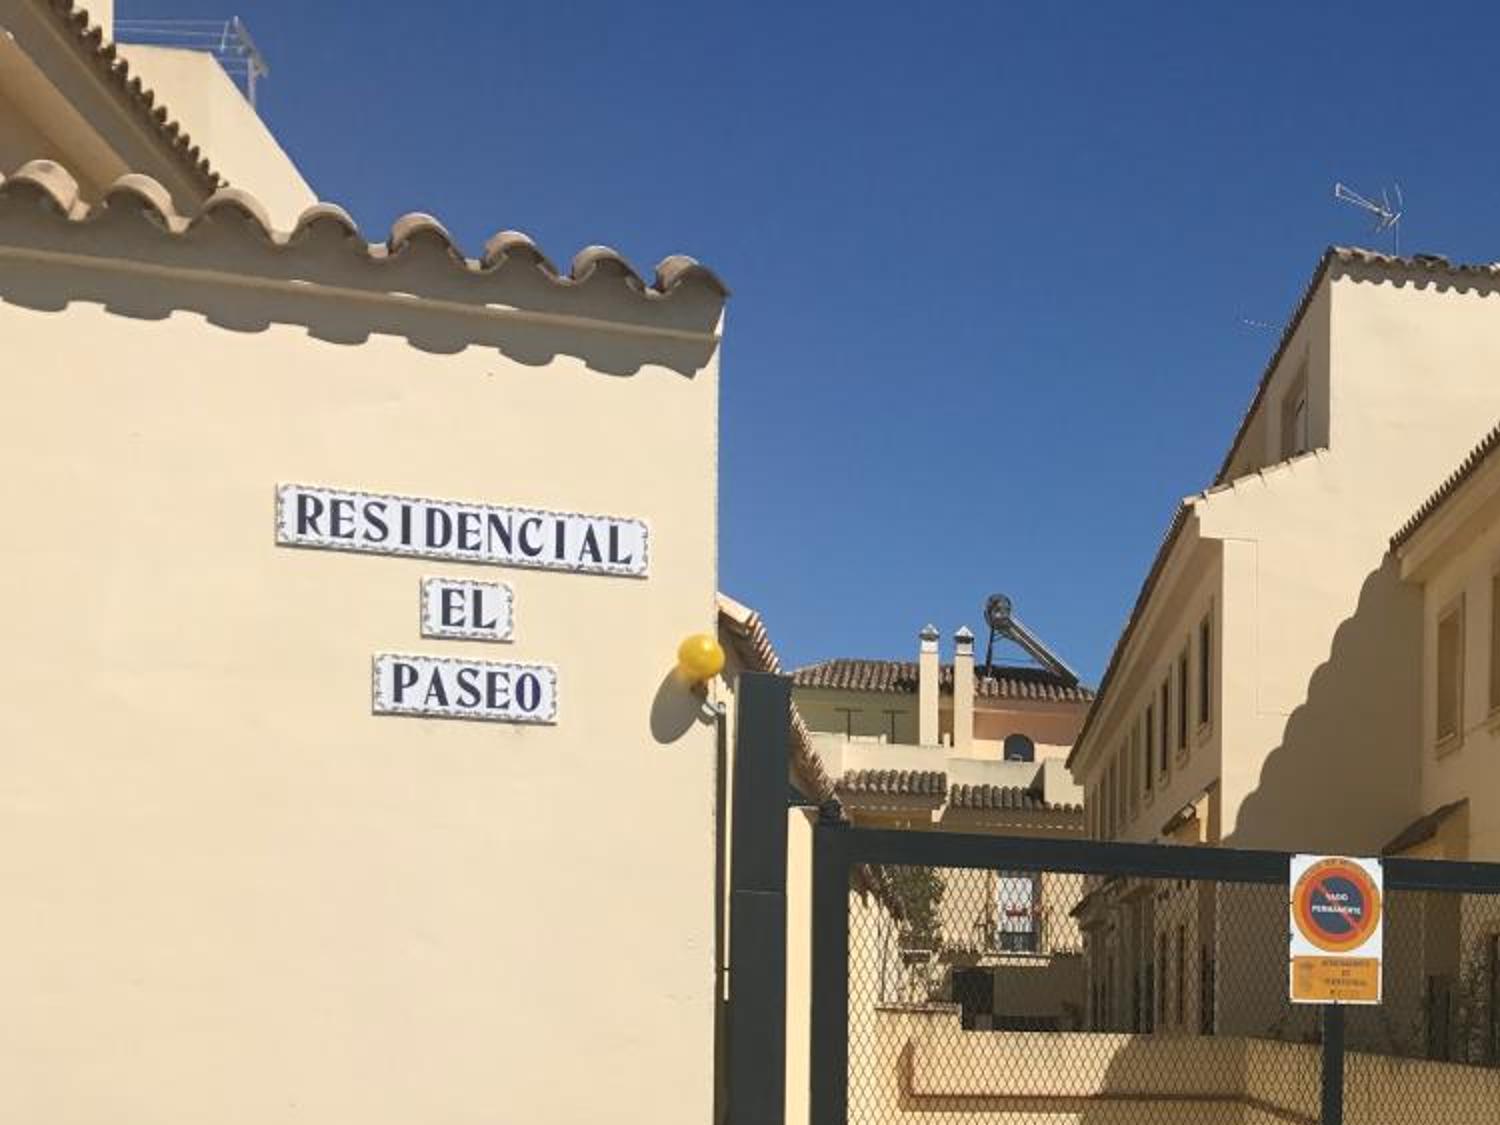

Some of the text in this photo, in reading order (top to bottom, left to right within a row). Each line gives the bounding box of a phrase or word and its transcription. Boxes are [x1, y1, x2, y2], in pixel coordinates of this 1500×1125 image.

[296, 493, 633, 565] RESIDENCIAL
[440, 587, 497, 629] EL
[391, 662, 542, 713] PASEO
